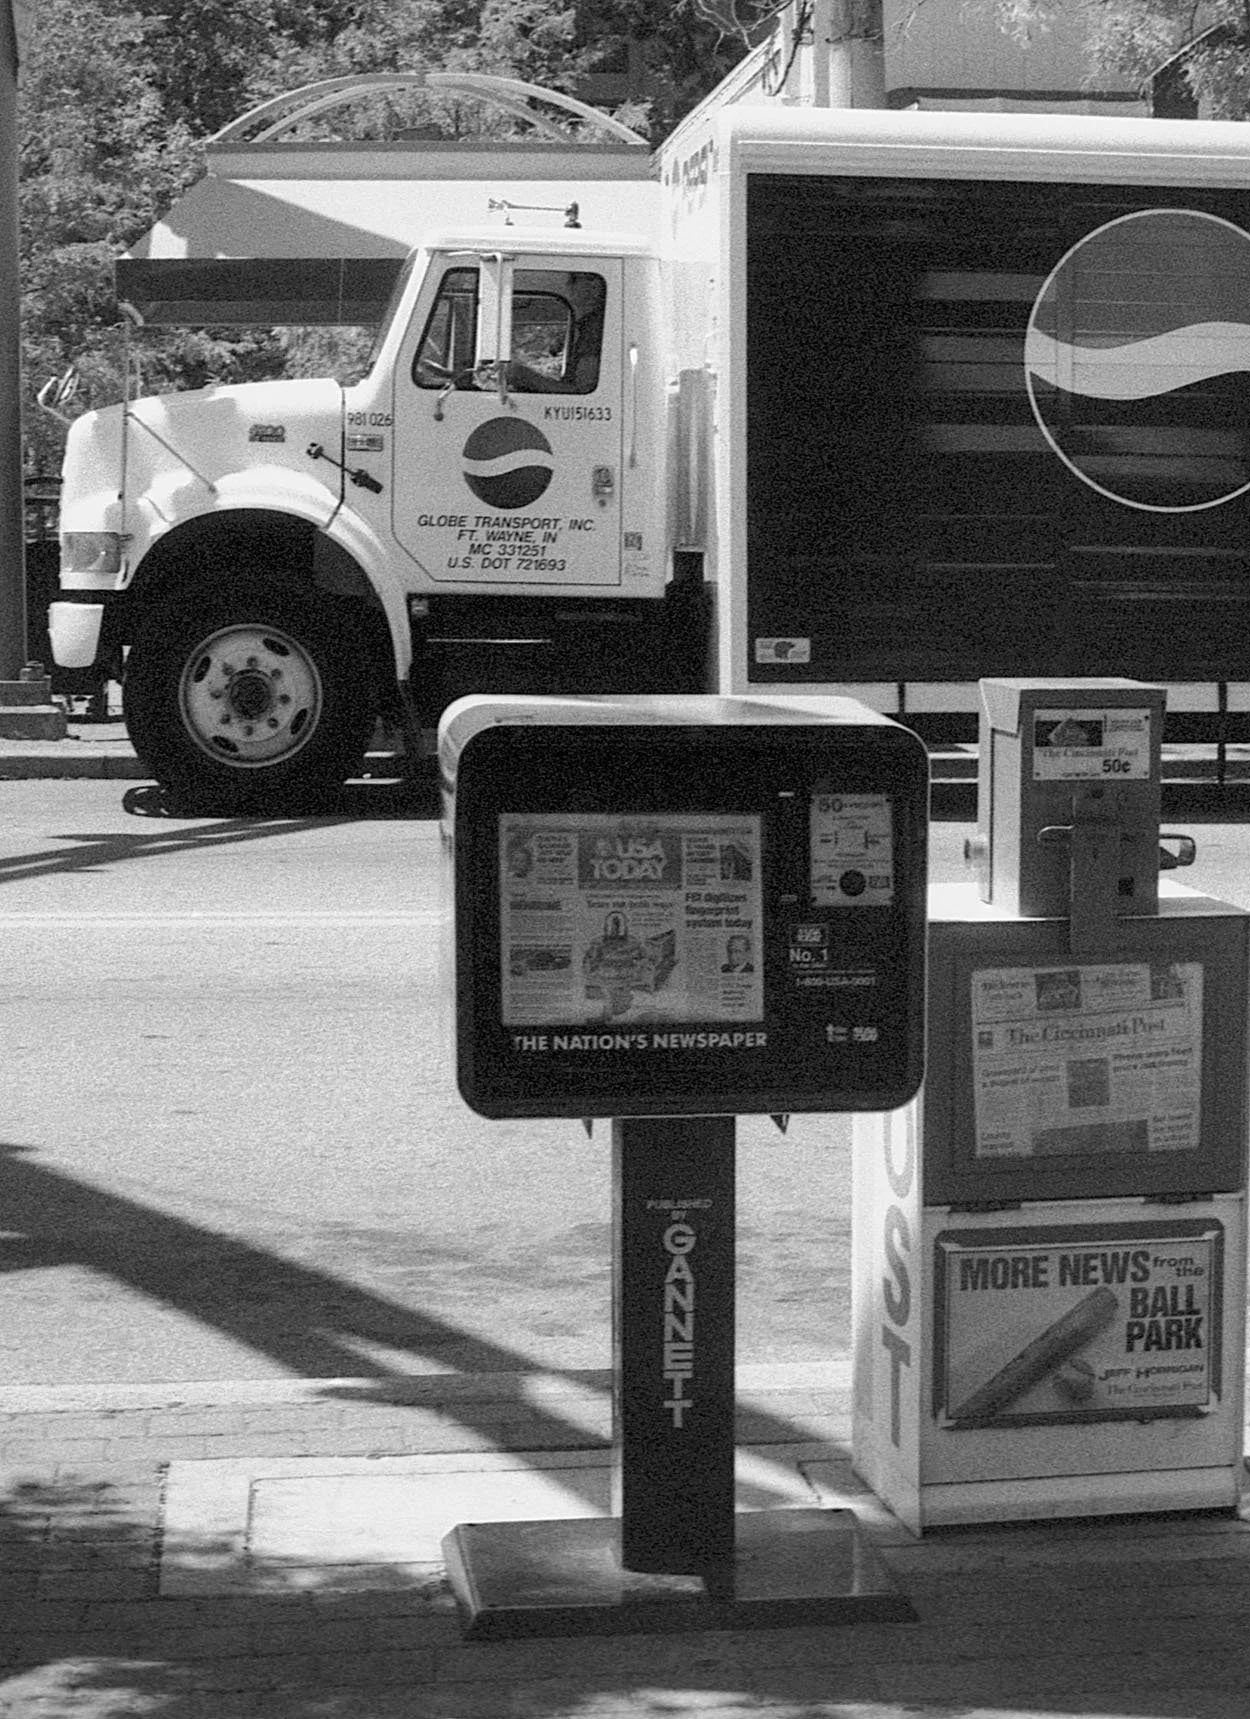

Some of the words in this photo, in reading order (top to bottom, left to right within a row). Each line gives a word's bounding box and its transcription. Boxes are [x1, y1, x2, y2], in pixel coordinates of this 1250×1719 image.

[348, 412, 366, 425] 981
[369, 413, 393, 427] 026
[543, 406, 612, 421] KYU151633
[417, 515, 467, 528] GLOBE
[474, 516, 562, 532] TRANSPORT,
[568, 519, 596, 532] INC.
[457, 530, 477, 541] FT.
[486, 531, 536, 544] WAYNE,
[543, 532, 558, 544] IN
[468, 544, 493, 556] MC
[499, 544, 547, 557] 331251
[447, 557, 475, 569] U.S.
[481, 558, 508, 570] DOT
[516, 559, 566, 571] 721693
[1102, 759, 1132, 774] 50¢
[618, 838, 665, 858] USA
[590, 859, 667, 880] TODAY
[789, 948, 815, 961] No.
[821, 948, 828, 961] 1
[514, 1035, 549, 1051] THE
[553, 1034, 648, 1050] NATION'S
[653, 1032, 768, 1049] NEWSPAPER
[960, 1256, 1049, 1291] MORE
[1059, 1251, 1150, 1287] NEWS
[1152, 1256, 1194, 1268] from
[1176, 1267, 1204, 1278] the
[1130, 1284, 1200, 1319] BALL
[663, 1223, 697, 1429] GANNETT
[1125, 1317, 1204, 1352] PARK
